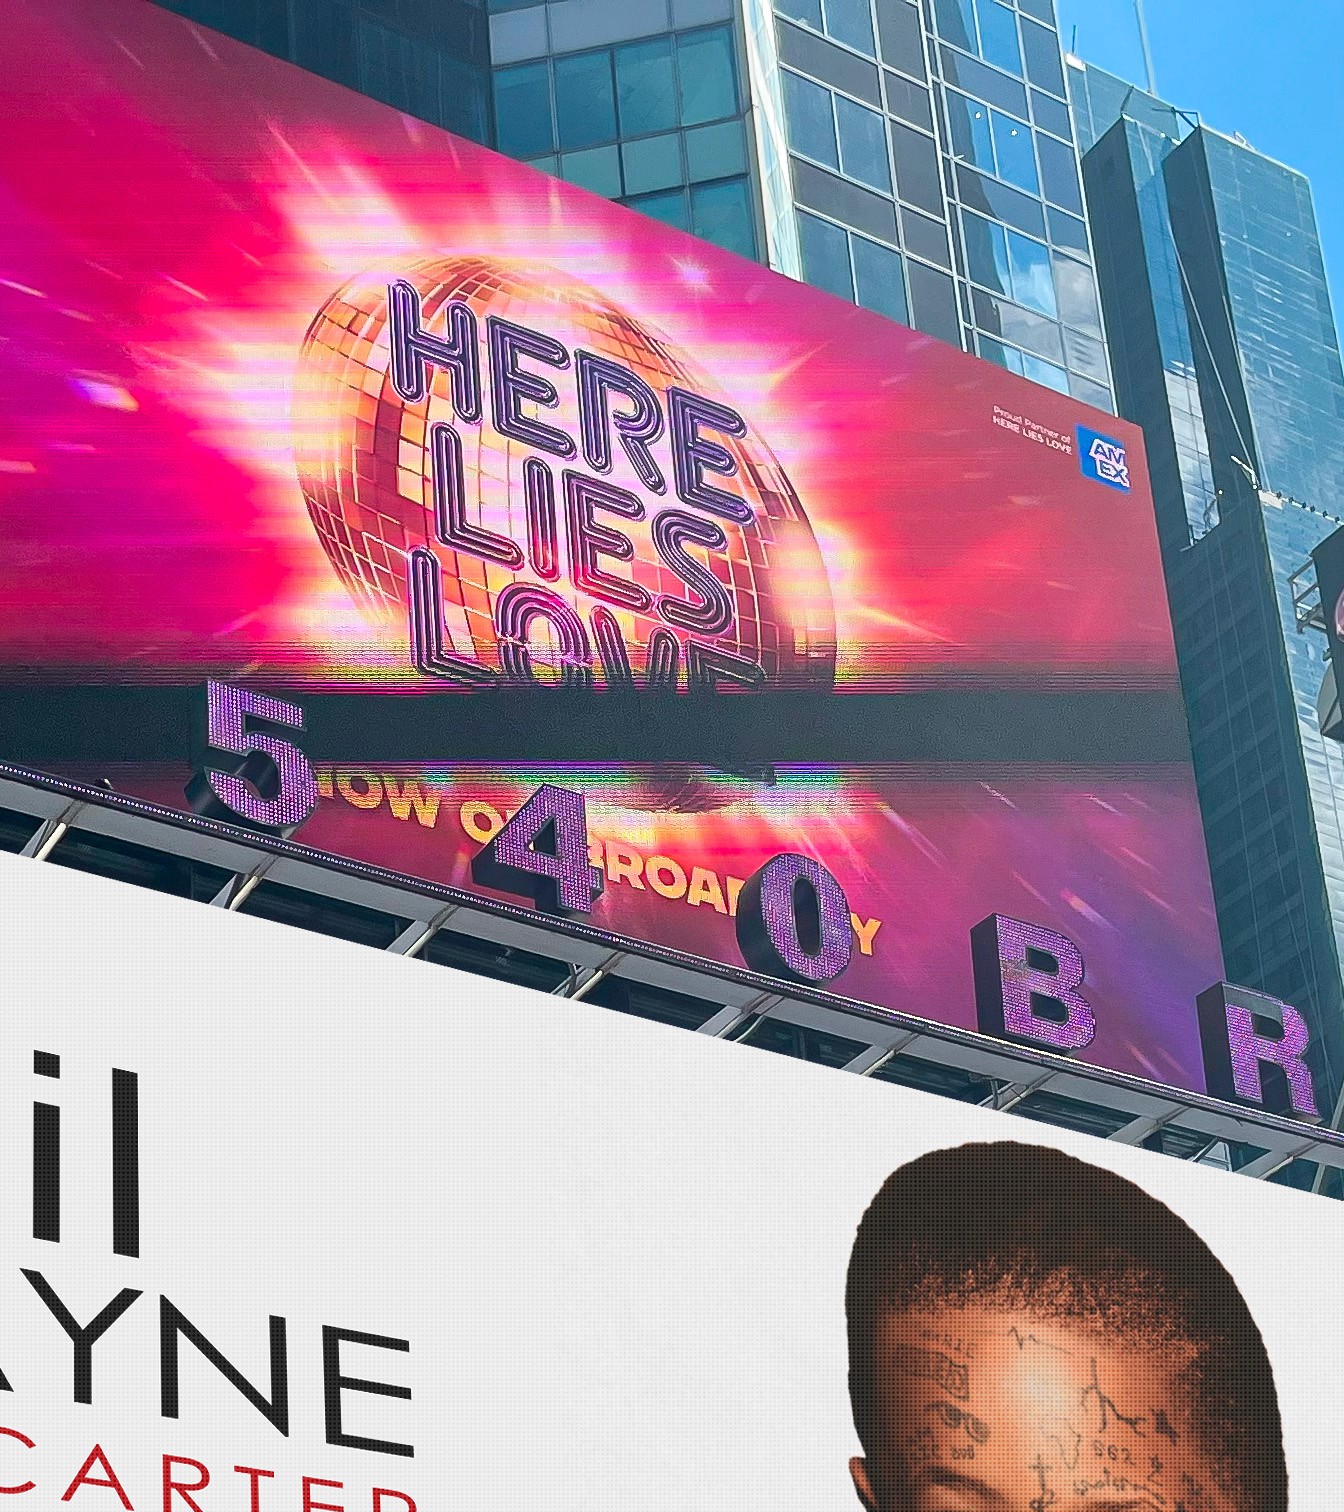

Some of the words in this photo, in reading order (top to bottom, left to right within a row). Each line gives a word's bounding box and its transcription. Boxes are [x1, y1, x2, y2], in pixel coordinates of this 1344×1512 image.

[388, 279, 754, 527] HERE
[992, 415, 1020, 433] HERE
[1022, 427, 1044, 444] LIES
[1046, 437, 1072, 455] LOVE
[993, 405, 1022, 424] Proud
[1024, 417, 1059, 439] Partner
[1061, 434, 1071, 445] of
[1089, 438, 1126, 466] AM
[1096, 459, 1131, 487] EX
[430, 420, 736, 636] LIES
[460, 800, 519, 845] O
[587, 835, 882, 956] ROAY
